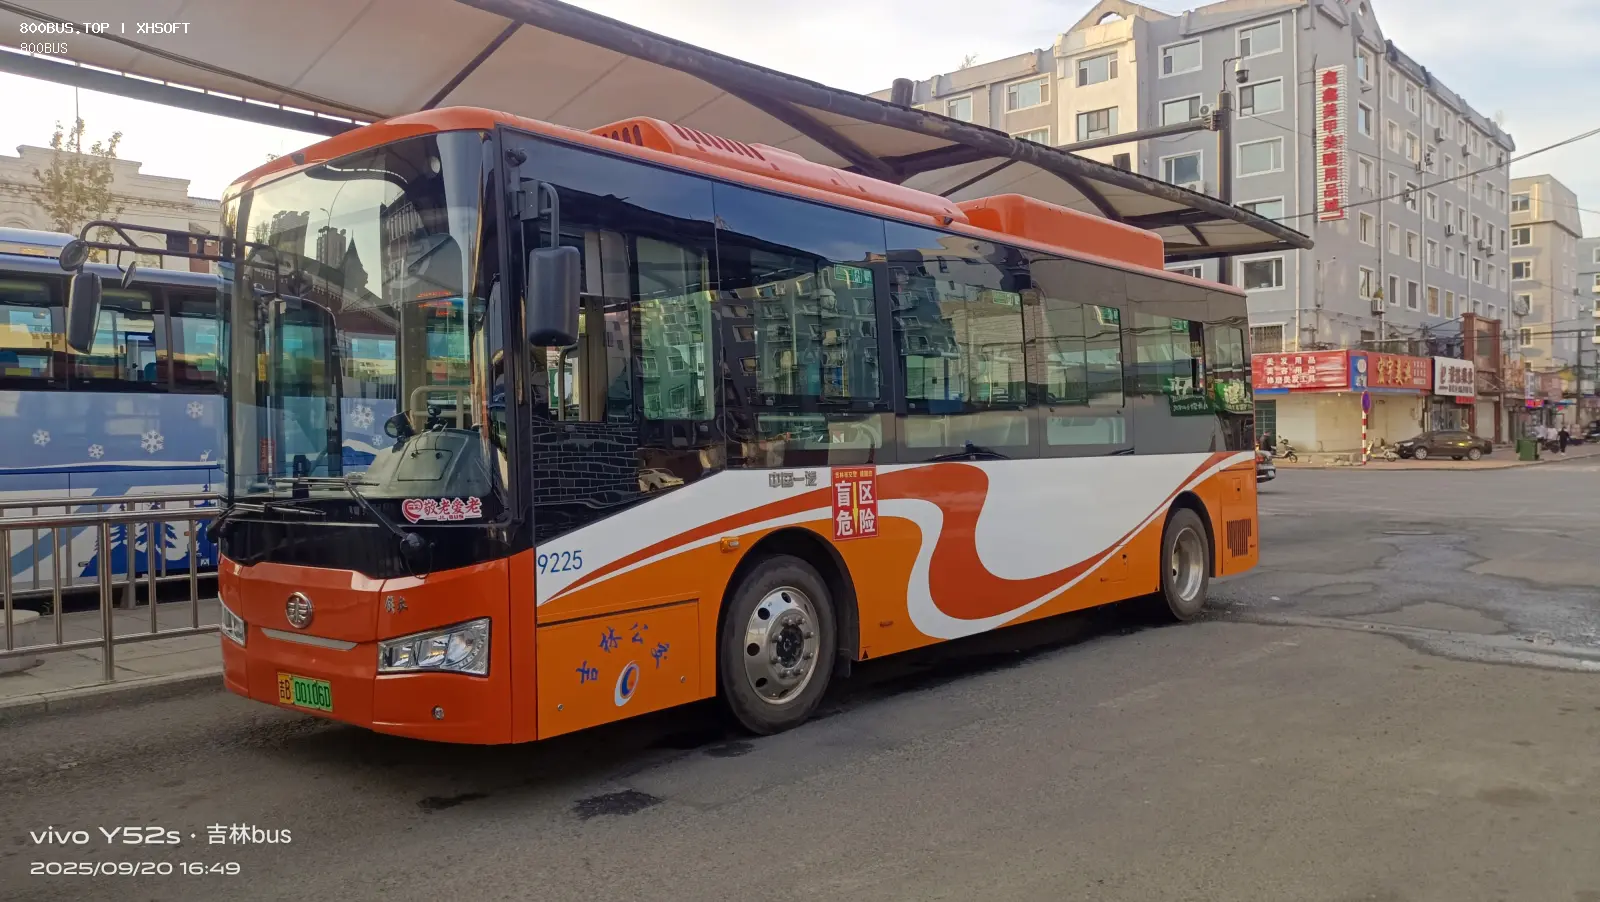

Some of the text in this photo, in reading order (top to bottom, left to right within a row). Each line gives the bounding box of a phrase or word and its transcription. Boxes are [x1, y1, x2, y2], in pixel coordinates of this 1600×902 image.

[423, 497, 481, 516] 敬老爱老
[835, 480, 874, 508] 盲区
[836, 508, 876, 537] 危险
[537, 550, 583, 575] 9225
